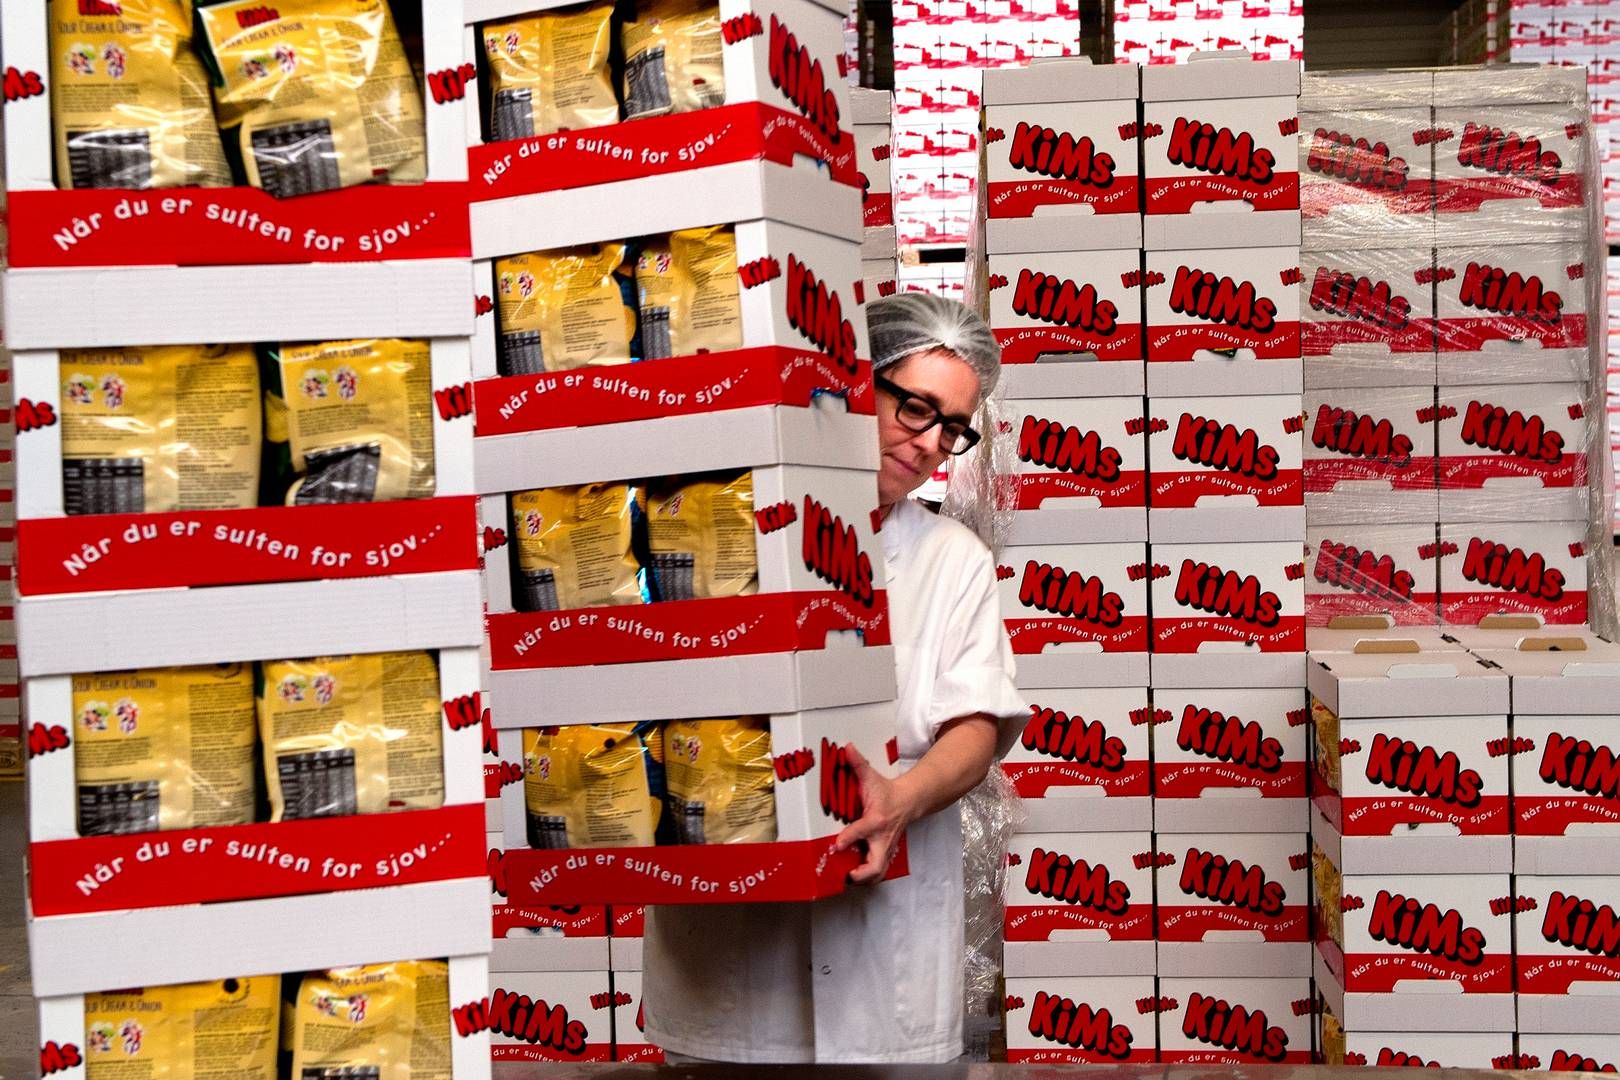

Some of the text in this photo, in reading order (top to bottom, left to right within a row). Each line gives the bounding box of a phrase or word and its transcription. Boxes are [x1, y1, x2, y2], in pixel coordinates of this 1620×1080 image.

[769, 13, 840, 144] KiMs
[482, 153, 513, 186] Når
[518, 140, 541, 159] du
[547, 137, 567, 150] er
[576, 138, 633, 161] sulten
[641, 148, 669, 164] for
[1010, 121, 1116, 188] KiMs
[1167, 116, 1275, 184] KiMs
[1457, 121, 1562, 184] KiMs
[993, 190, 1011, 205] Når
[1015, 185, 1028, 193] du
[1031, 183, 1044, 191] er
[1047, 185, 1080, 200] sulten
[1083, 193, 1099, 203] for
[1151, 185, 1169, 201] Når
[1172, 180, 1186, 189] du
[1189, 179, 1202, 187] er
[1206, 181, 1239, 196] sulten
[1242, 189, 1258, 199] for
[53, 212, 102, 251] Når
[114, 199, 149, 219] du
[161, 198, 193, 214] er
[206, 203, 292, 242] sulten
[303, 228, 345, 252] for
[787, 253, 858, 376] KiMs
[1012, 268, 1118, 336] KiMs
[1169, 265, 1277, 332] KiMs
[1309, 266, 1412, 329] KiMs
[1459, 261, 1564, 324] KiMs
[1153, 334, 1171, 349] Når
[1174, 328, 1188, 337] du
[1208, 329, 1240, 345] sulten
[1243, 338, 1260, 348] for
[498, 389, 529, 421] Når
[535, 378, 557, 394] du
[564, 374, 584, 387] er
[592, 376, 650, 401] sulten
[657, 389, 686, 405] for
[1018, 415, 1122, 482] KiMs
[1172, 413, 1280, 480] KiMs
[1312, 404, 1414, 467] KiMs
[1461, 400, 1565, 464] KiMs
[1156, 480, 1174, 495] Når
[1177, 475, 1191, 484] du
[1211, 477, 1243, 492] sulten
[1246, 485, 1263, 495] for
[63, 538, 111, 576] Når
[123, 523, 158, 544] du
[169, 521, 201, 536] er
[214, 525, 299, 560] sulten
[311, 545, 352, 567] for
[802, 494, 873, 608] KiMs
[1314, 539, 1415, 602] KiMs
[1462, 537, 1566, 601] KiMs
[1019, 560, 1124, 627] KiMs
[1175, 559, 1282, 627] KiMs
[513, 627, 543, 656] Når
[549, 615, 572, 633] du
[578, 614, 598, 626] er
[606, 616, 665, 643] sulten
[672, 631, 701, 649] for
[1159, 626, 1177, 641] Når
[1180, 621, 1193, 630] du
[1196, 620, 1209, 628] er
[1213, 622, 1245, 638] sulten
[1248, 632, 1265, 641] for
[1021, 704, 1127, 771] KiMs
[1177, 704, 1284, 772] KiMs
[1539, 732, 1620, 803] KiM
[820, 737, 864, 825] Ki
[1366, 733, 1483, 808] KiMs
[1348, 806, 1368, 822] Når
[1372, 801, 1386, 810] du
[1390, 800, 1403, 808] er
[1408, 802, 1443, 820] sulten
[1447, 813, 1465, 823] for
[1521, 800, 1618, 821] Når du er sulten
[76, 857, 123, 896] Når
[136, 841, 170, 862] du
[182, 838, 213, 853] er
[226, 840, 310, 873] sulten
[322, 857, 362, 878] for
[529, 865, 559, 893] Når
[565, 855, 588, 870] du
[595, 853, 616, 866] er
[624, 857, 683, 886] sulten
[690, 875, 720, 893] for
[1025, 848, 1130, 915] KiMs
[1179, 848, 1286, 916] KiMs
[504, 907, 515, 915] er
[519, 910, 549, 925] sulten
[552, 918, 567, 928] for
[616, 910, 633, 926] Når
[1010, 914, 1028, 929] Når
[1031, 909, 1044, 918] du
[1063, 911, 1095, 926] sulten
[1098, 920, 1114, 929] for
[1368, 890, 1486, 966] KiMs
[1541, 891, 1620, 960] KiM
[1351, 962, 1370, 978] Når
[1374, 957, 1389, 967] du
[1393, 957, 1406, 965] er
[1411, 960, 1446, 977] sulten
[1449, 971, 1468, 982] for
[490, 988, 588, 1055] KiMs
[1028, 991, 1133, 1059] KiMs
[1182, 992, 1289, 1061] KiMs
